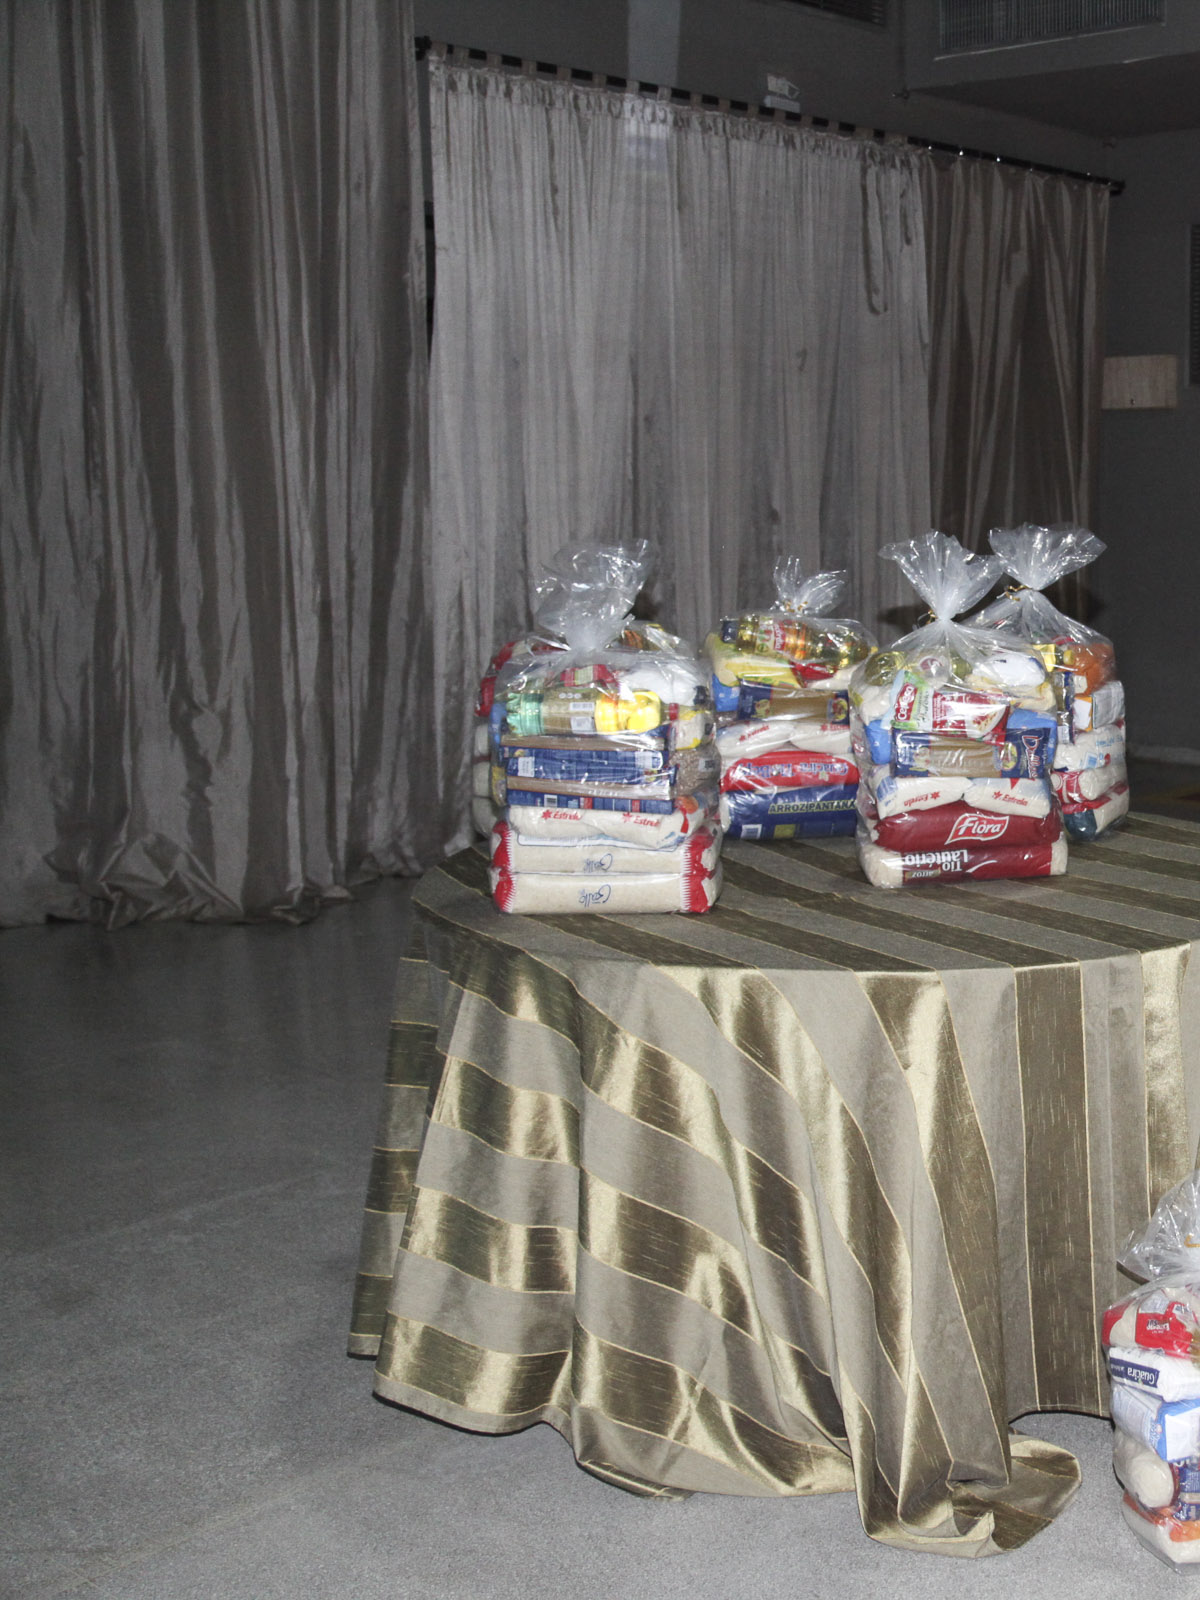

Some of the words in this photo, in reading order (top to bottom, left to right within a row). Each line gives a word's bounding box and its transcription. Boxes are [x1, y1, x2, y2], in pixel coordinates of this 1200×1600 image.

[768, 802, 807, 814] ARROZ
[957, 816, 1002, 836] Flora
[904, 850, 969, 867] Lautério
[941, 860, 963, 872] Tio
[1127, 1367, 1156, 1385] Guacira
